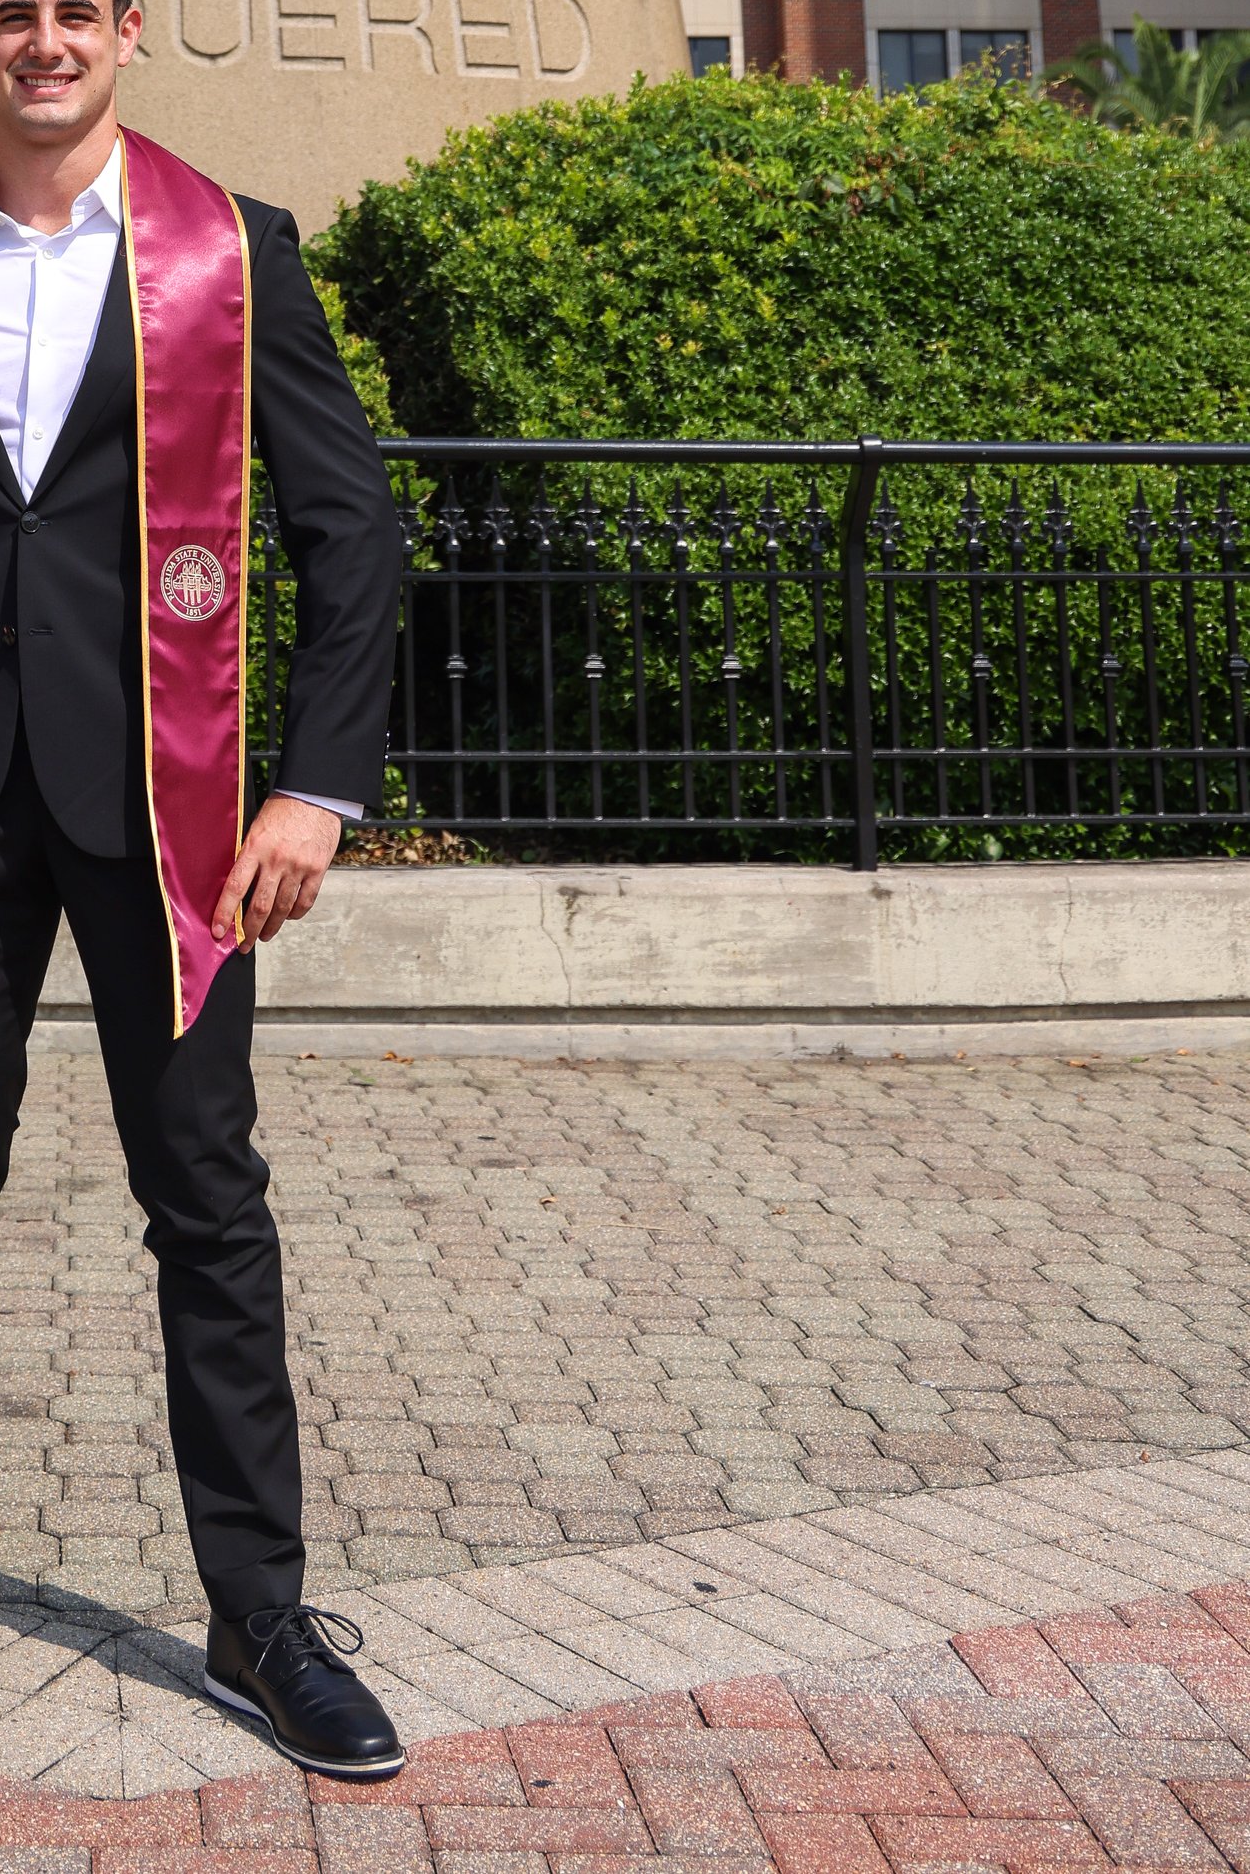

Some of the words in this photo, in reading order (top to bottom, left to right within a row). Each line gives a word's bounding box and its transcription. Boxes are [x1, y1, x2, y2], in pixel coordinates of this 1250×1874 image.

[164, 561, 176, 601] FLORIDA
[174, 550, 198, 562] STATE
[200, 553, 221, 604] UNIVERSITY
[185, 608, 202, 616] 1851
